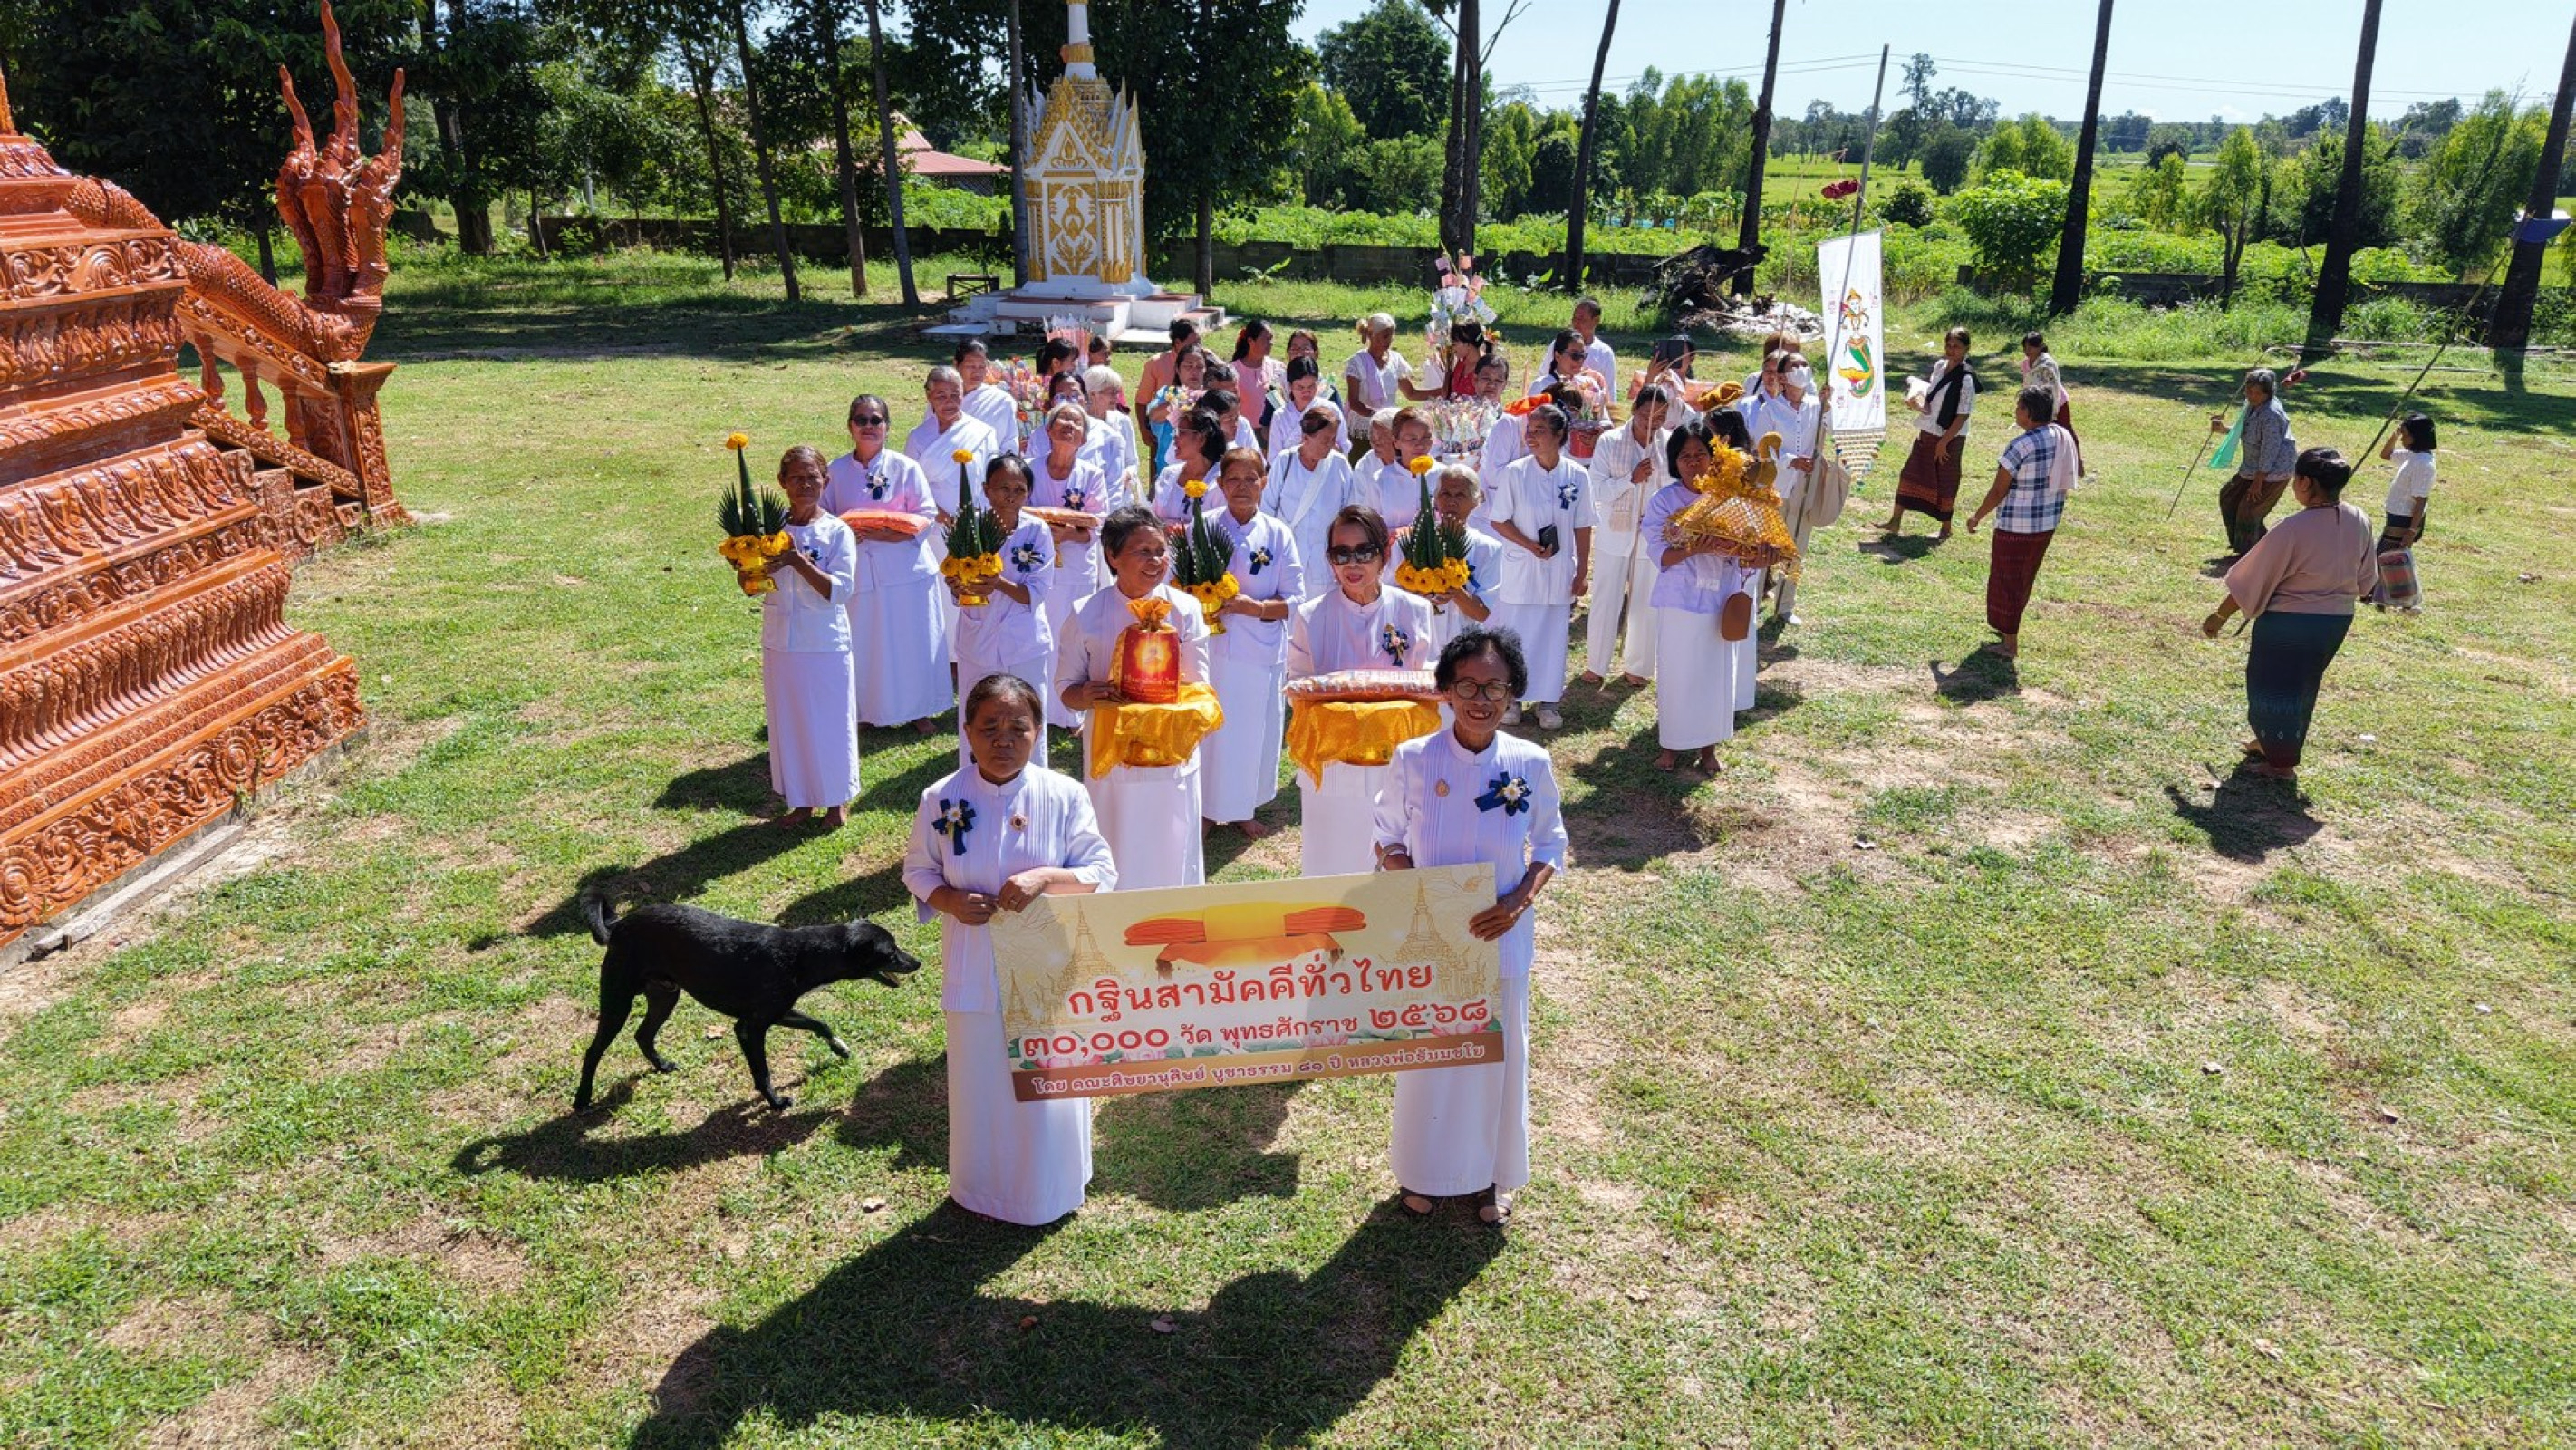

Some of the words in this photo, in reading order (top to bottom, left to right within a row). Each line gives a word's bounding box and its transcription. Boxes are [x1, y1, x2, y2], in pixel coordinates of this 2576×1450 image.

[1068, 954, 1433, 1023] กฐินสามัคคีทั่วไทย
[1024, 1029, 1170, 1057] ๓๐,๐๐๐
[1180, 1024, 1212, 1044] วัด
[1220, 1017, 1358, 1049] พุทธศักราช
[1369, 999, 1488, 1030] ๒๕๖๘
[1034, 1078, 1066, 1092] โดย
[1073, 1066, 1204, 1090] คณะศิษยานุศิษย์
[1212, 1065, 1291, 1083] บูชาธรรม
[1329, 1054, 1341, 1068] ปี
